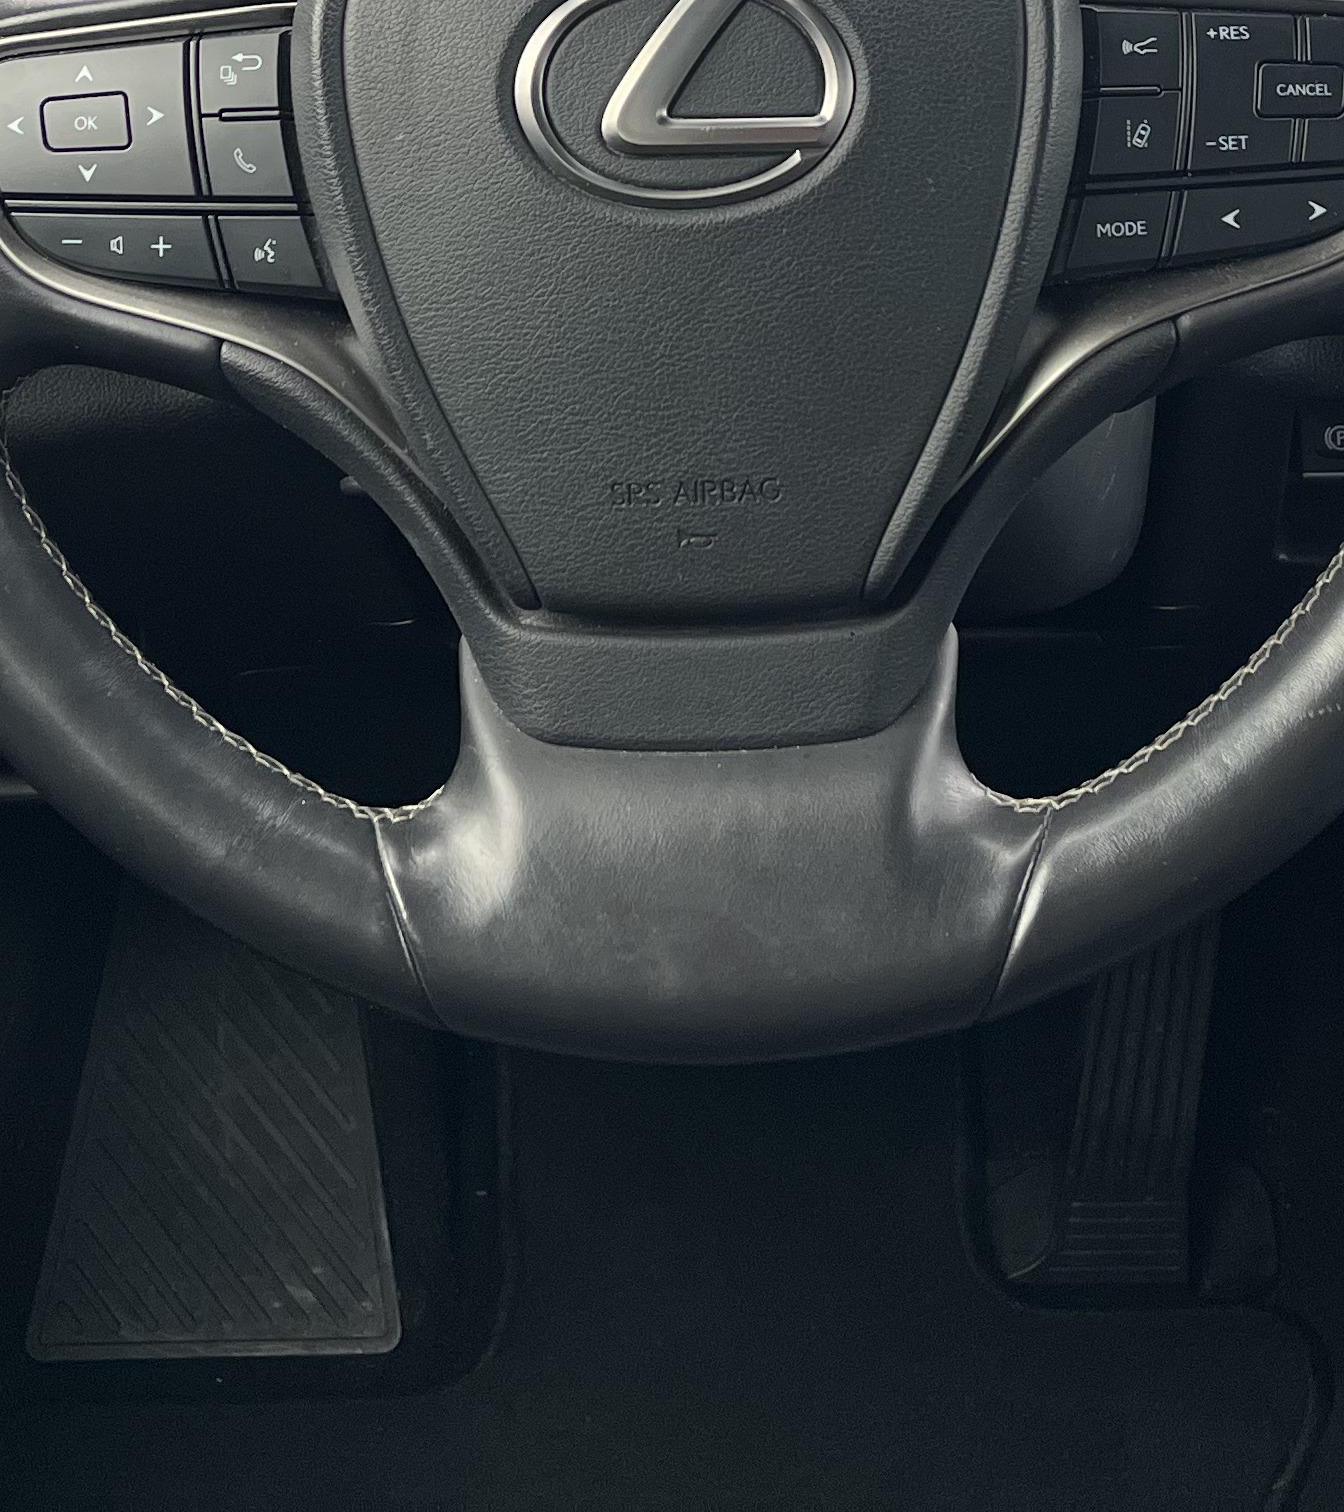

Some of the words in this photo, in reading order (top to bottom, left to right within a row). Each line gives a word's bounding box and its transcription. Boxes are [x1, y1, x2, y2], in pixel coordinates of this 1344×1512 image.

[1275, 84, 1332, 98] CANCEL
[74, 115, 98, 132] OK
[1096, 220, 1148, 238] MODE
[674, 477, 783, 505] AIRBAG
